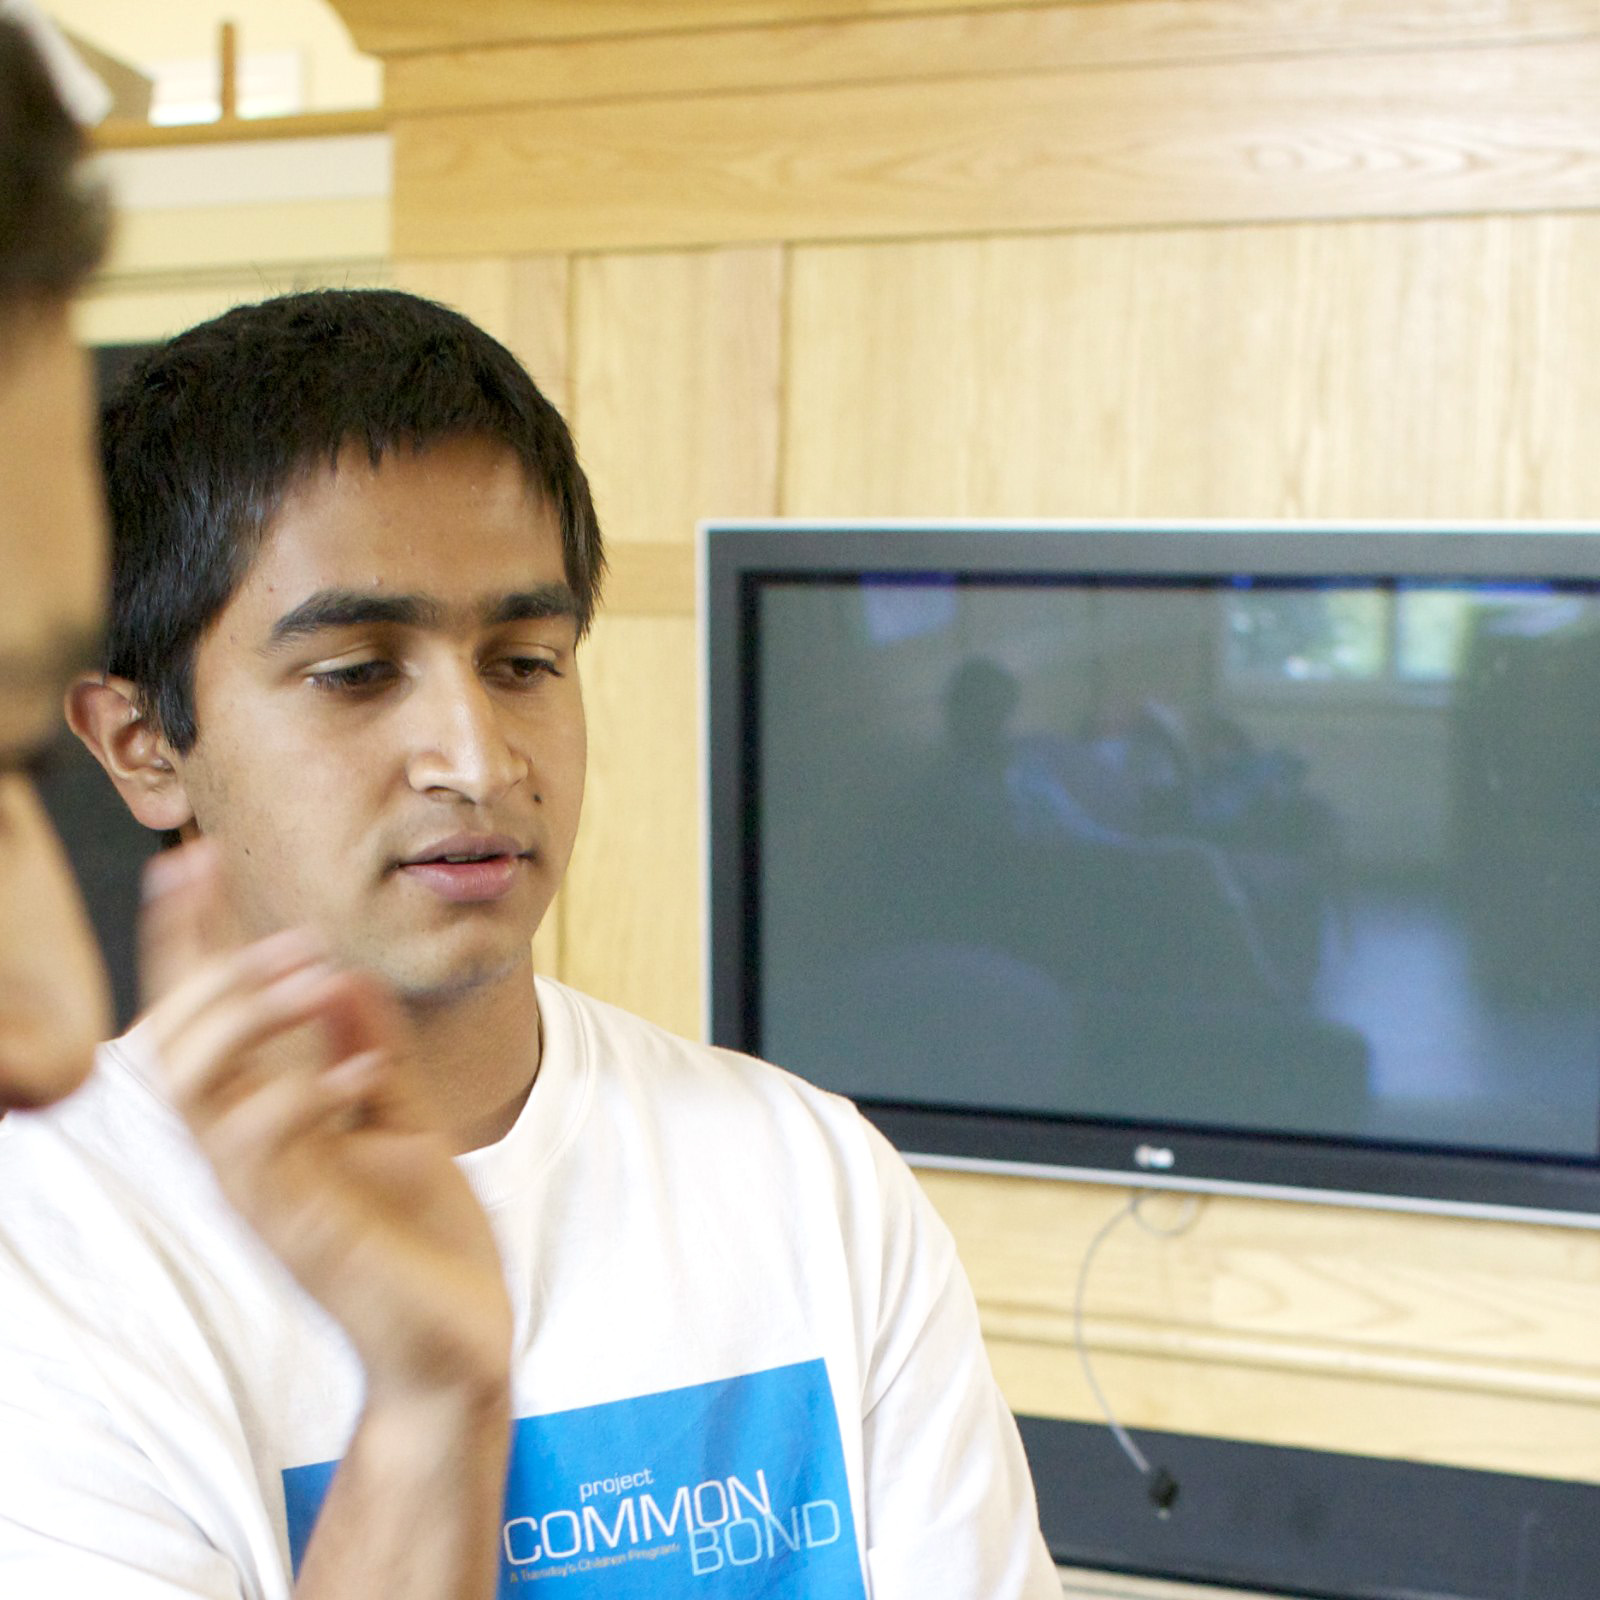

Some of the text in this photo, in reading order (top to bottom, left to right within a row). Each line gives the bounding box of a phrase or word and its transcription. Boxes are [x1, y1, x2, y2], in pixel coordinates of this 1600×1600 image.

[503, 1469, 772, 1566] COMMON
[579, 1468, 655, 1504] project
[689, 1499, 841, 1577] BOND
